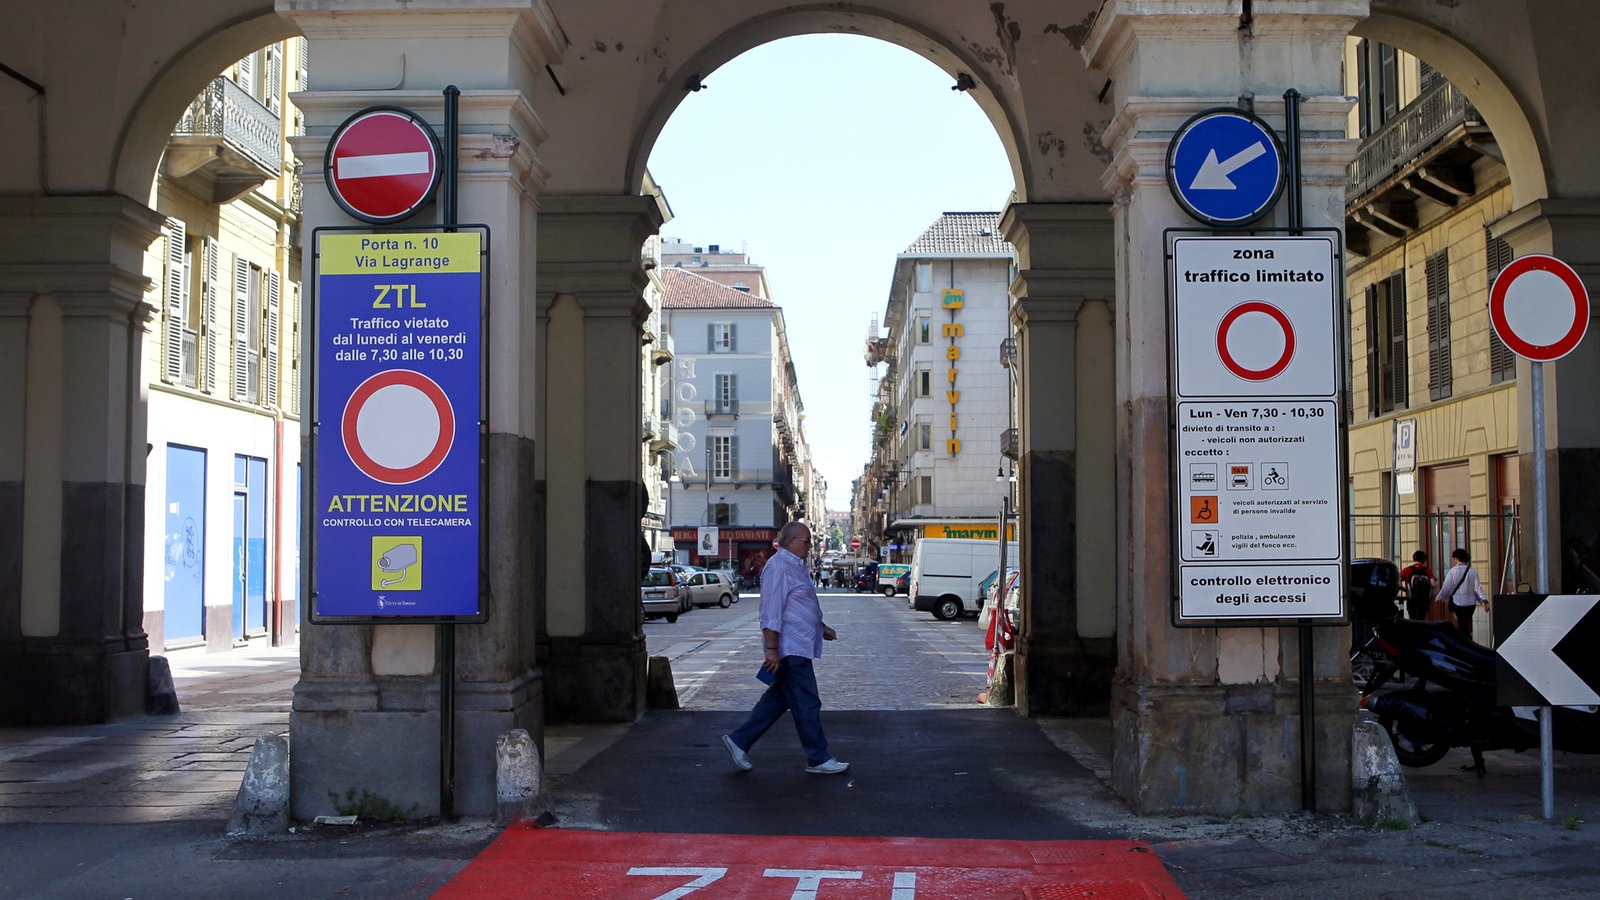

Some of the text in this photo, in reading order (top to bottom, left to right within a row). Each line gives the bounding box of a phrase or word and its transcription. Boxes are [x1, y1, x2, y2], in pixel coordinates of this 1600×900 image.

[362, 238, 438, 250] Porta n. 10
[1233, 250, 1274, 259] zona
[356, 256, 449, 269] Via Lagrange
[1185, 270, 1324, 282] traffico limitato
[373, 284, 426, 308] ZTL
[350, 317, 449, 329] Traffico vietato
[333, 334, 352, 345] dal
[402, 333, 412, 344] al
[336, 348, 464, 362] dalle 7,30 alle 10,30
[942, 323, 964, 454] marvin
[1190, 409, 1212, 418] Lun
[1224, 409, 1248, 418] Ven
[1252, 409, 1278, 419] 7,30
[1290, 408, 1324, 419] 10,30
[328, 495, 468, 512] ATTENZIONE
[323, 518, 381, 526] CONTROLLO
[408, 518, 472, 526] TELECAMERA
[946, 529, 997, 538] marvin
[1191, 575, 1330, 586] controllo elettronico
[1216, 593, 1306, 606] degli accessi
